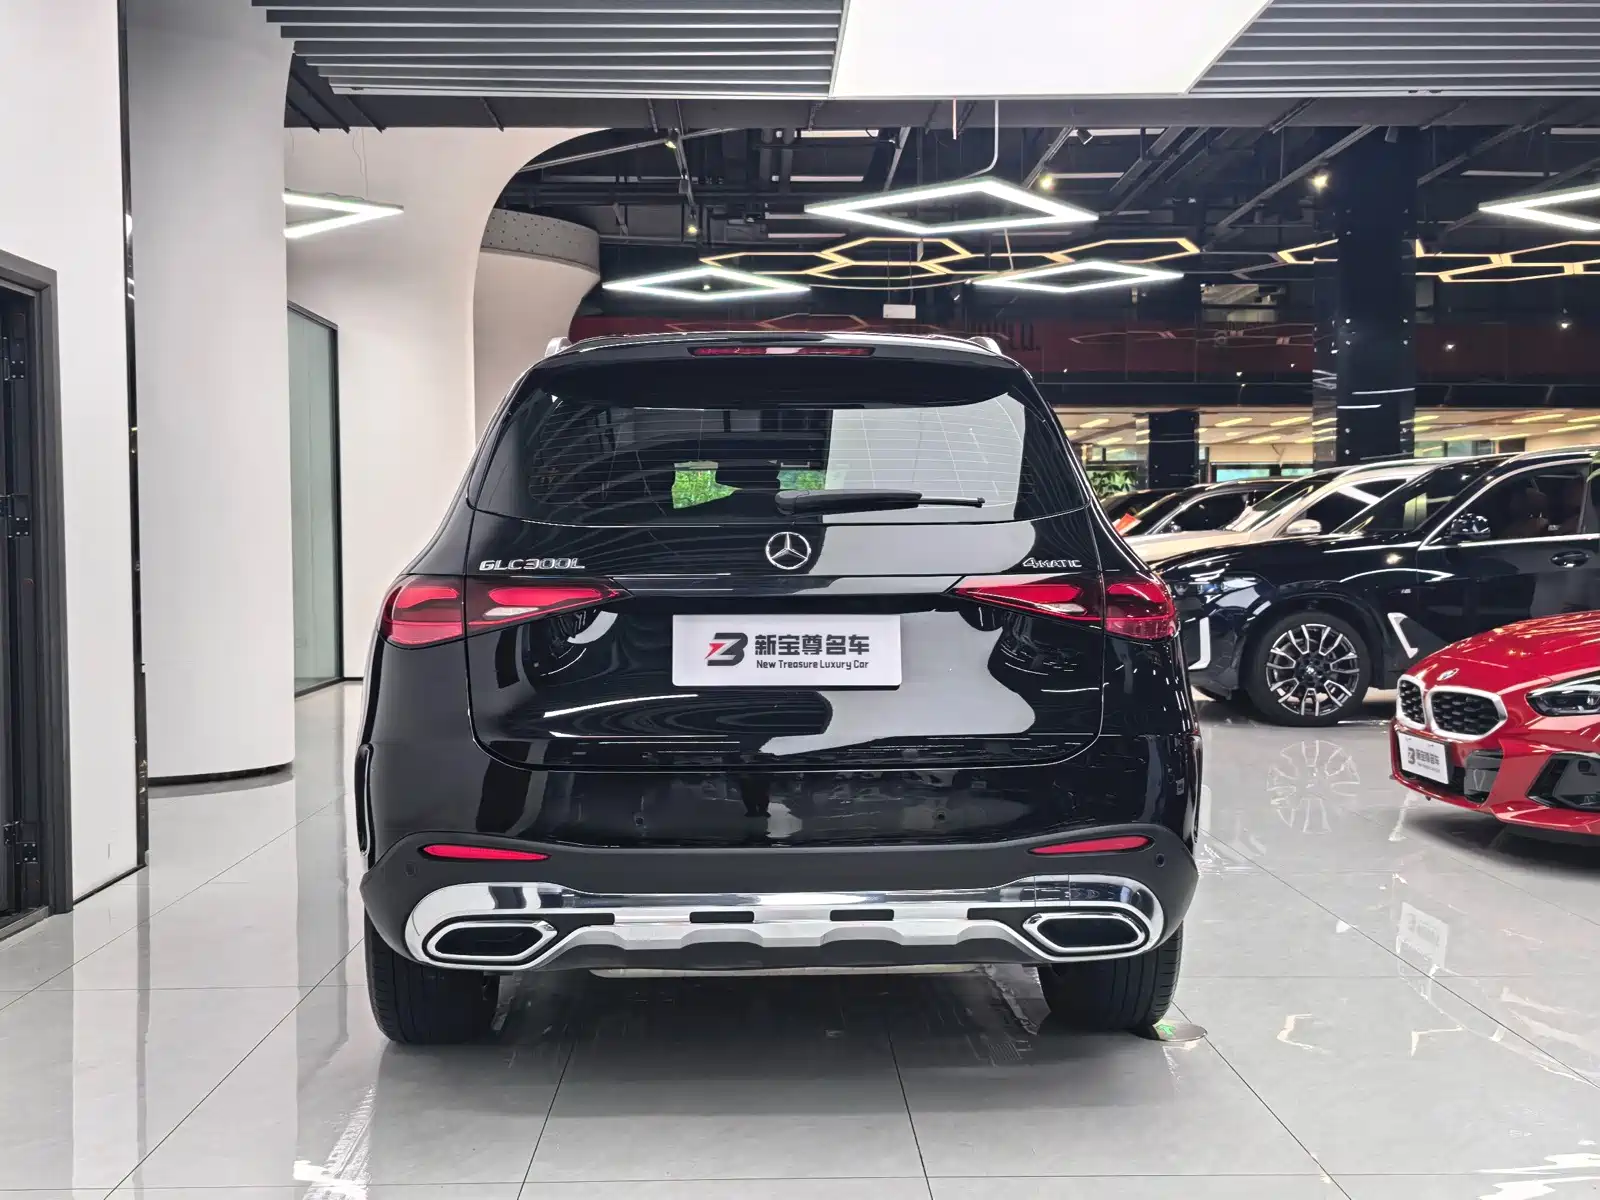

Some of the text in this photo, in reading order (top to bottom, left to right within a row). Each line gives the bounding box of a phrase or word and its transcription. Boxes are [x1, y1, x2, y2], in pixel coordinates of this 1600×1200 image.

[1022, 557, 1083, 568] 4MATIC
[754, 634, 870, 656] 新宝尊名车
[756, 659, 869, 671] New Treasure Luxury Car
